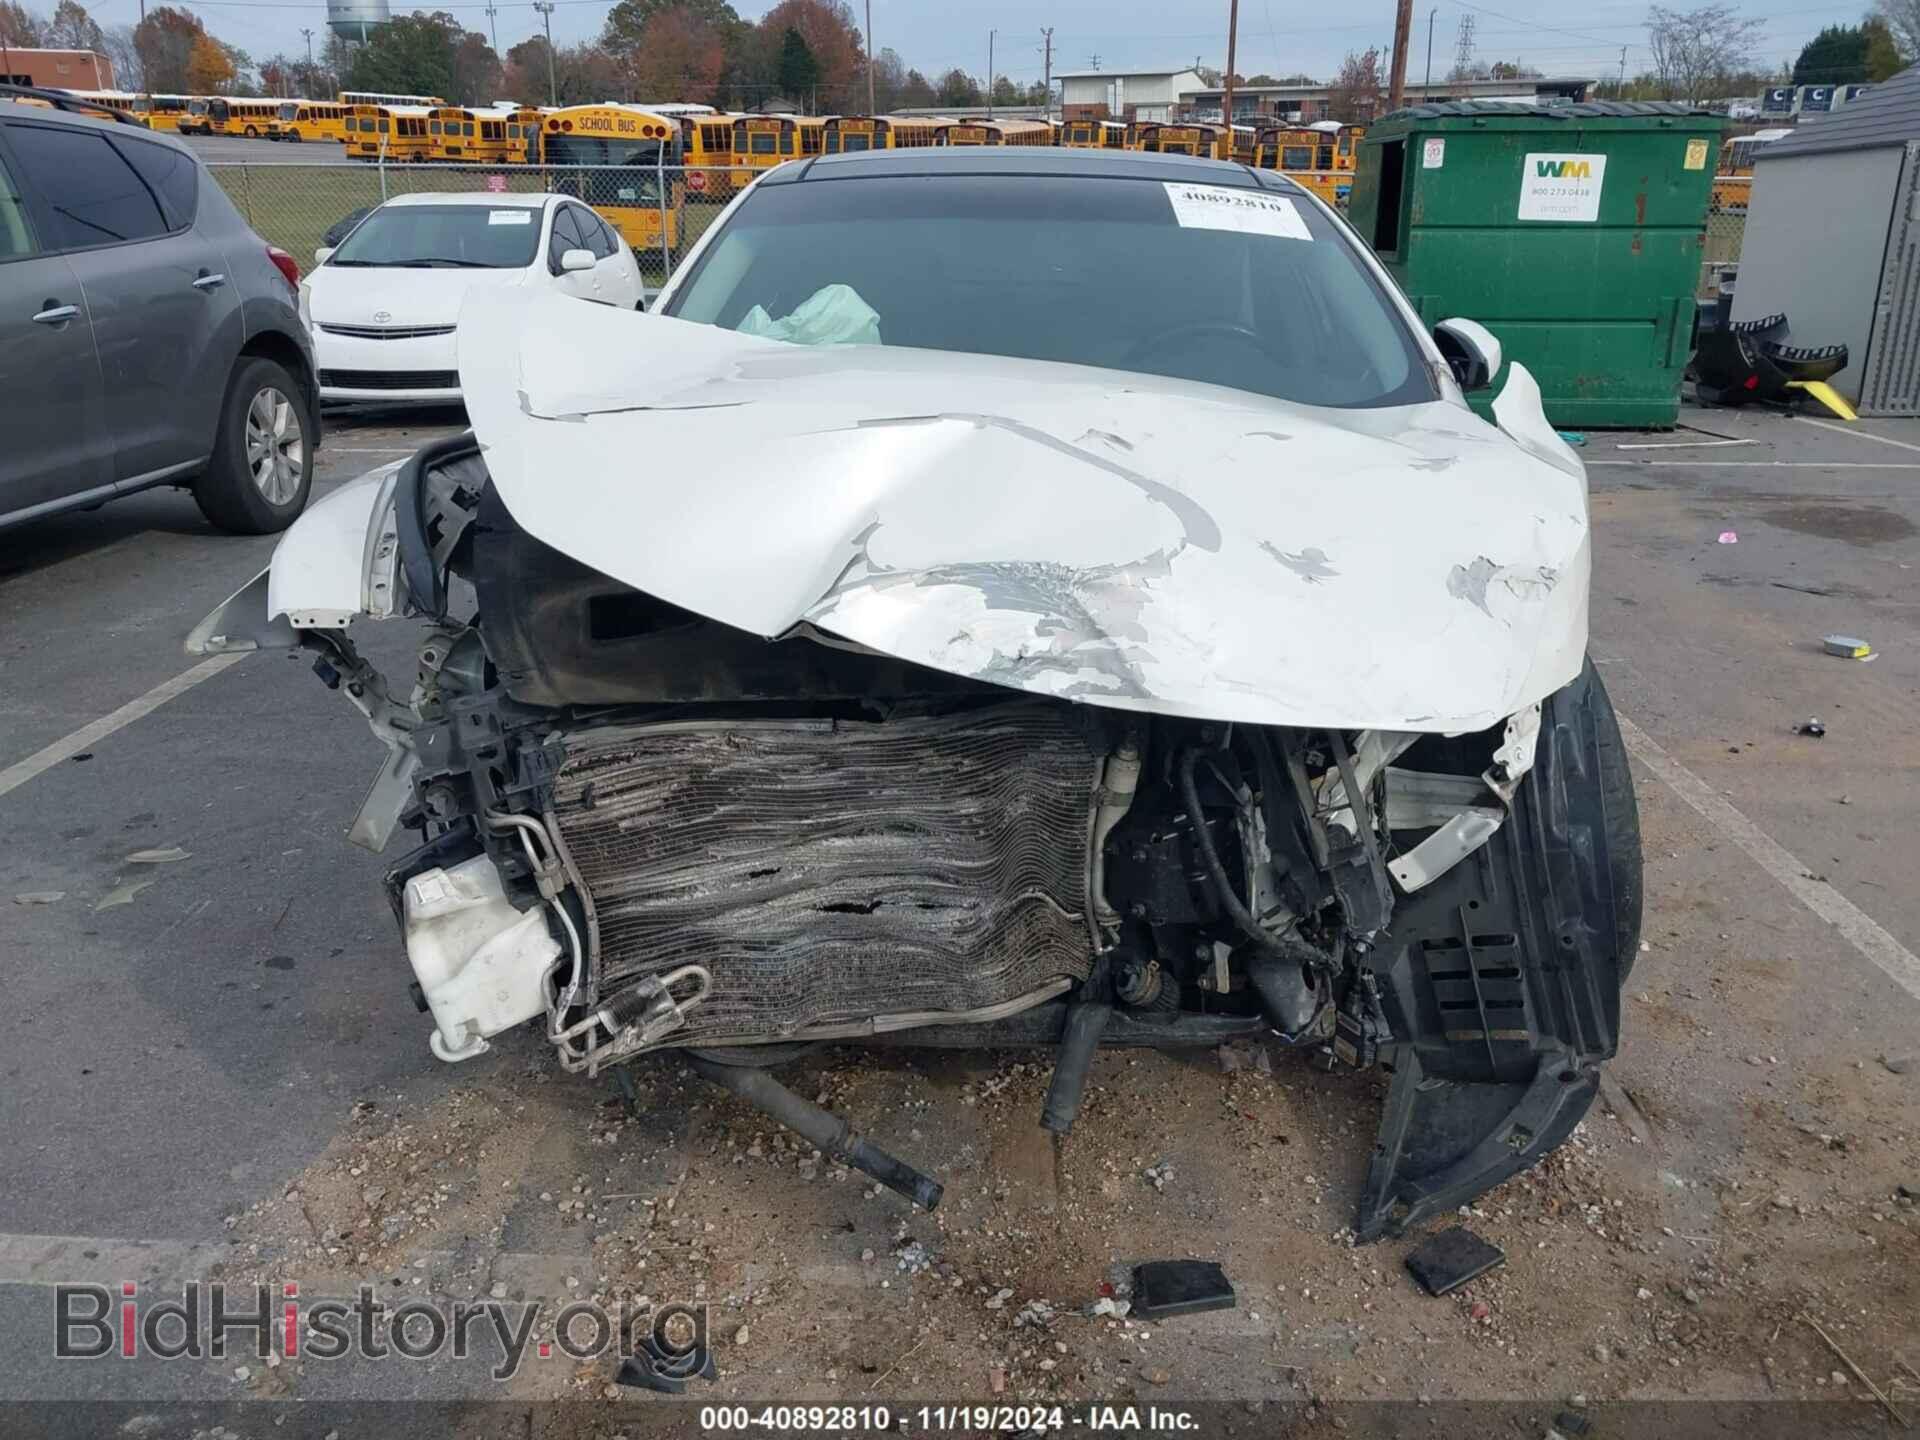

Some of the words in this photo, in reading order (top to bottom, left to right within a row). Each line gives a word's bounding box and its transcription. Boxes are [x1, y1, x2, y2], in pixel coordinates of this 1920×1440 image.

[1773, 89, 1784, 101] C
[1812, 88, 1824, 100] C
[579, 117, 614, 132] SCHOOL
[618, 119, 636, 133] BUS
[1536, 160, 1590, 177] WM
